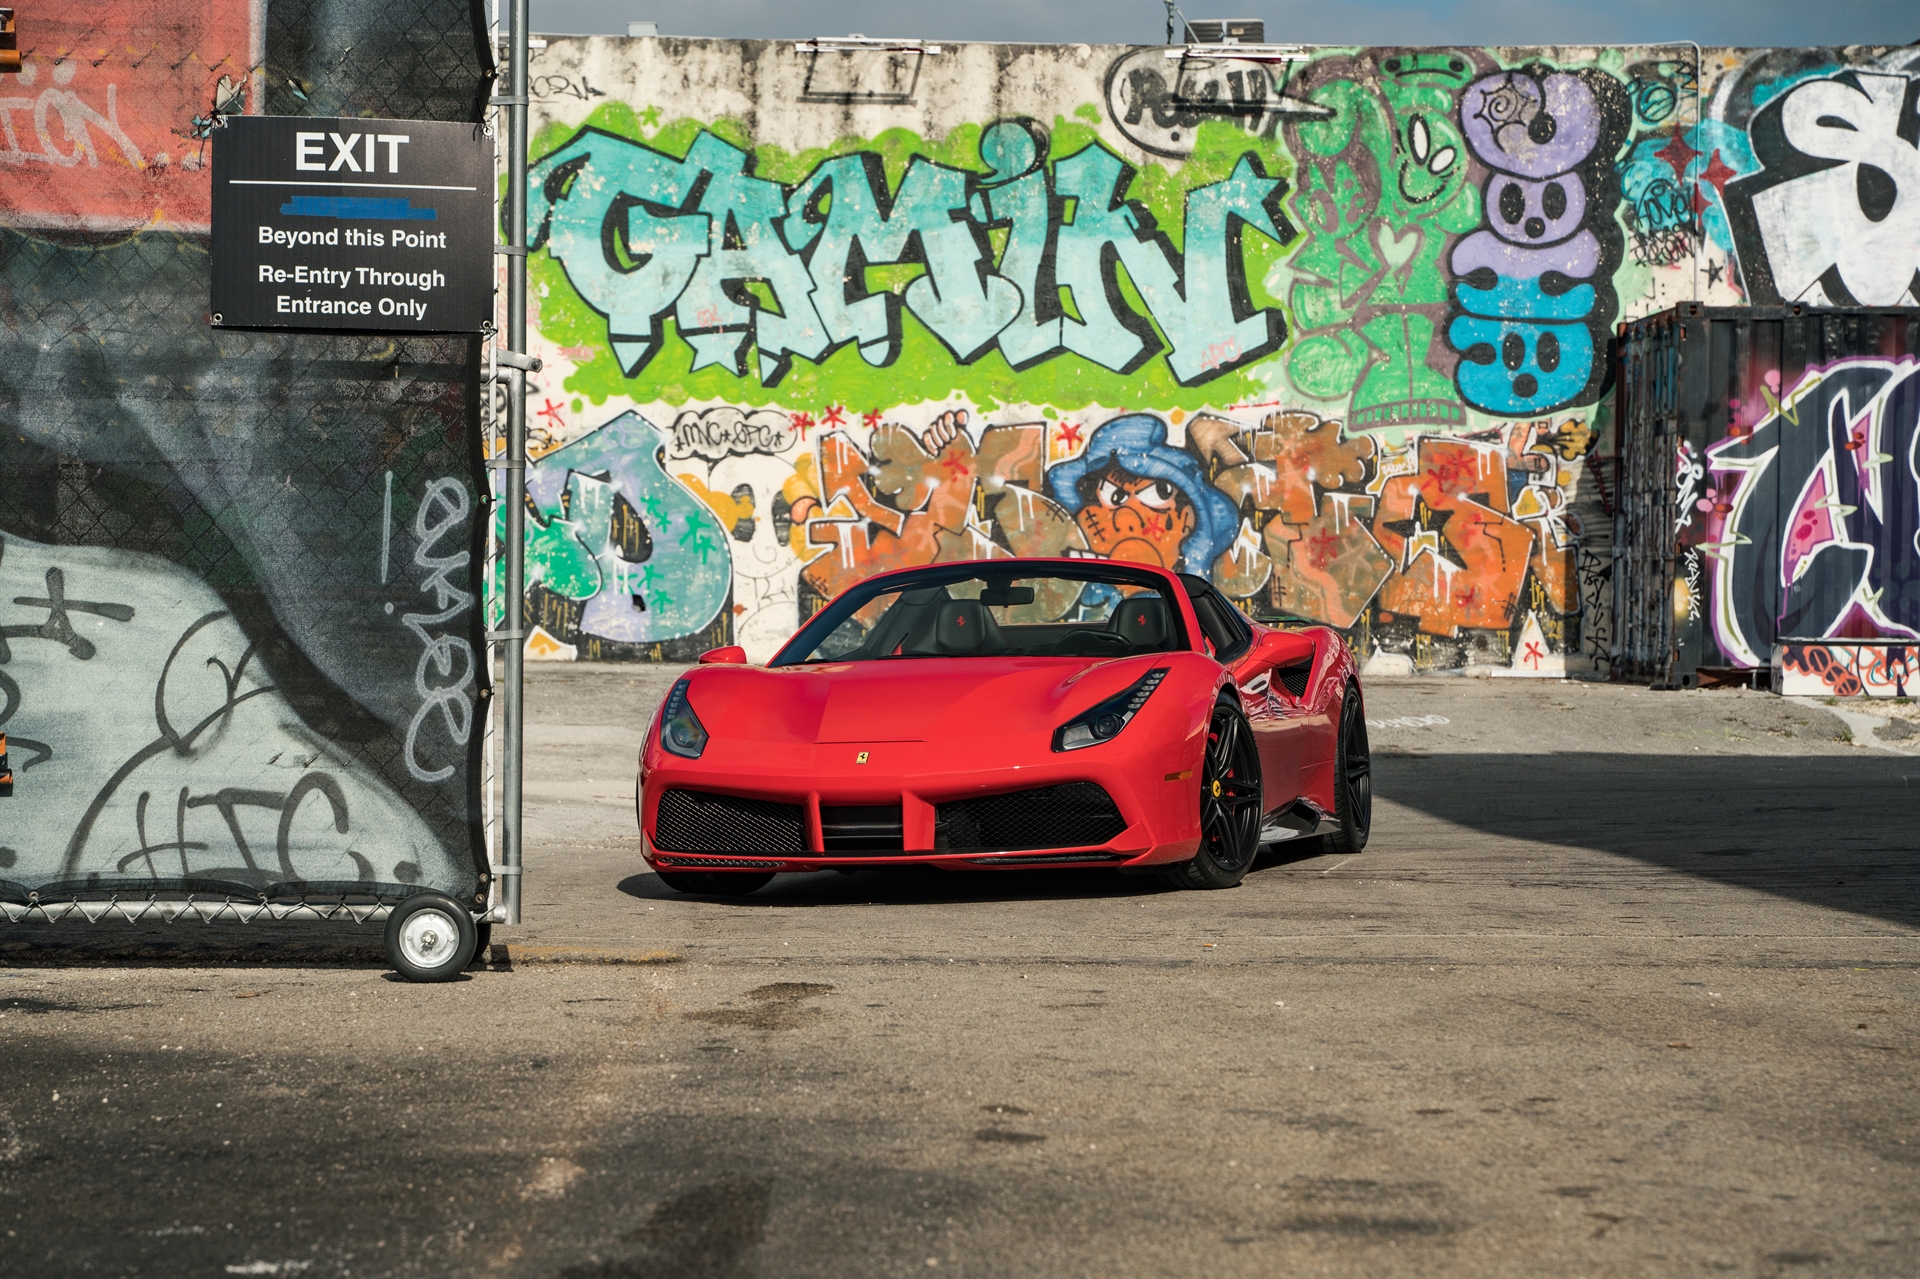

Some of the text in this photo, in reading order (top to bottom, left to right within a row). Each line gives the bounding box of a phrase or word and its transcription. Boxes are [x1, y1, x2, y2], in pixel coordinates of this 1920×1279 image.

[296, 131, 410, 174] EXIT
[258, 226, 447, 249] Beyond this Point
[258, 264, 446, 291] Re-Entry Through
[276, 295, 428, 321] Entrance Only
